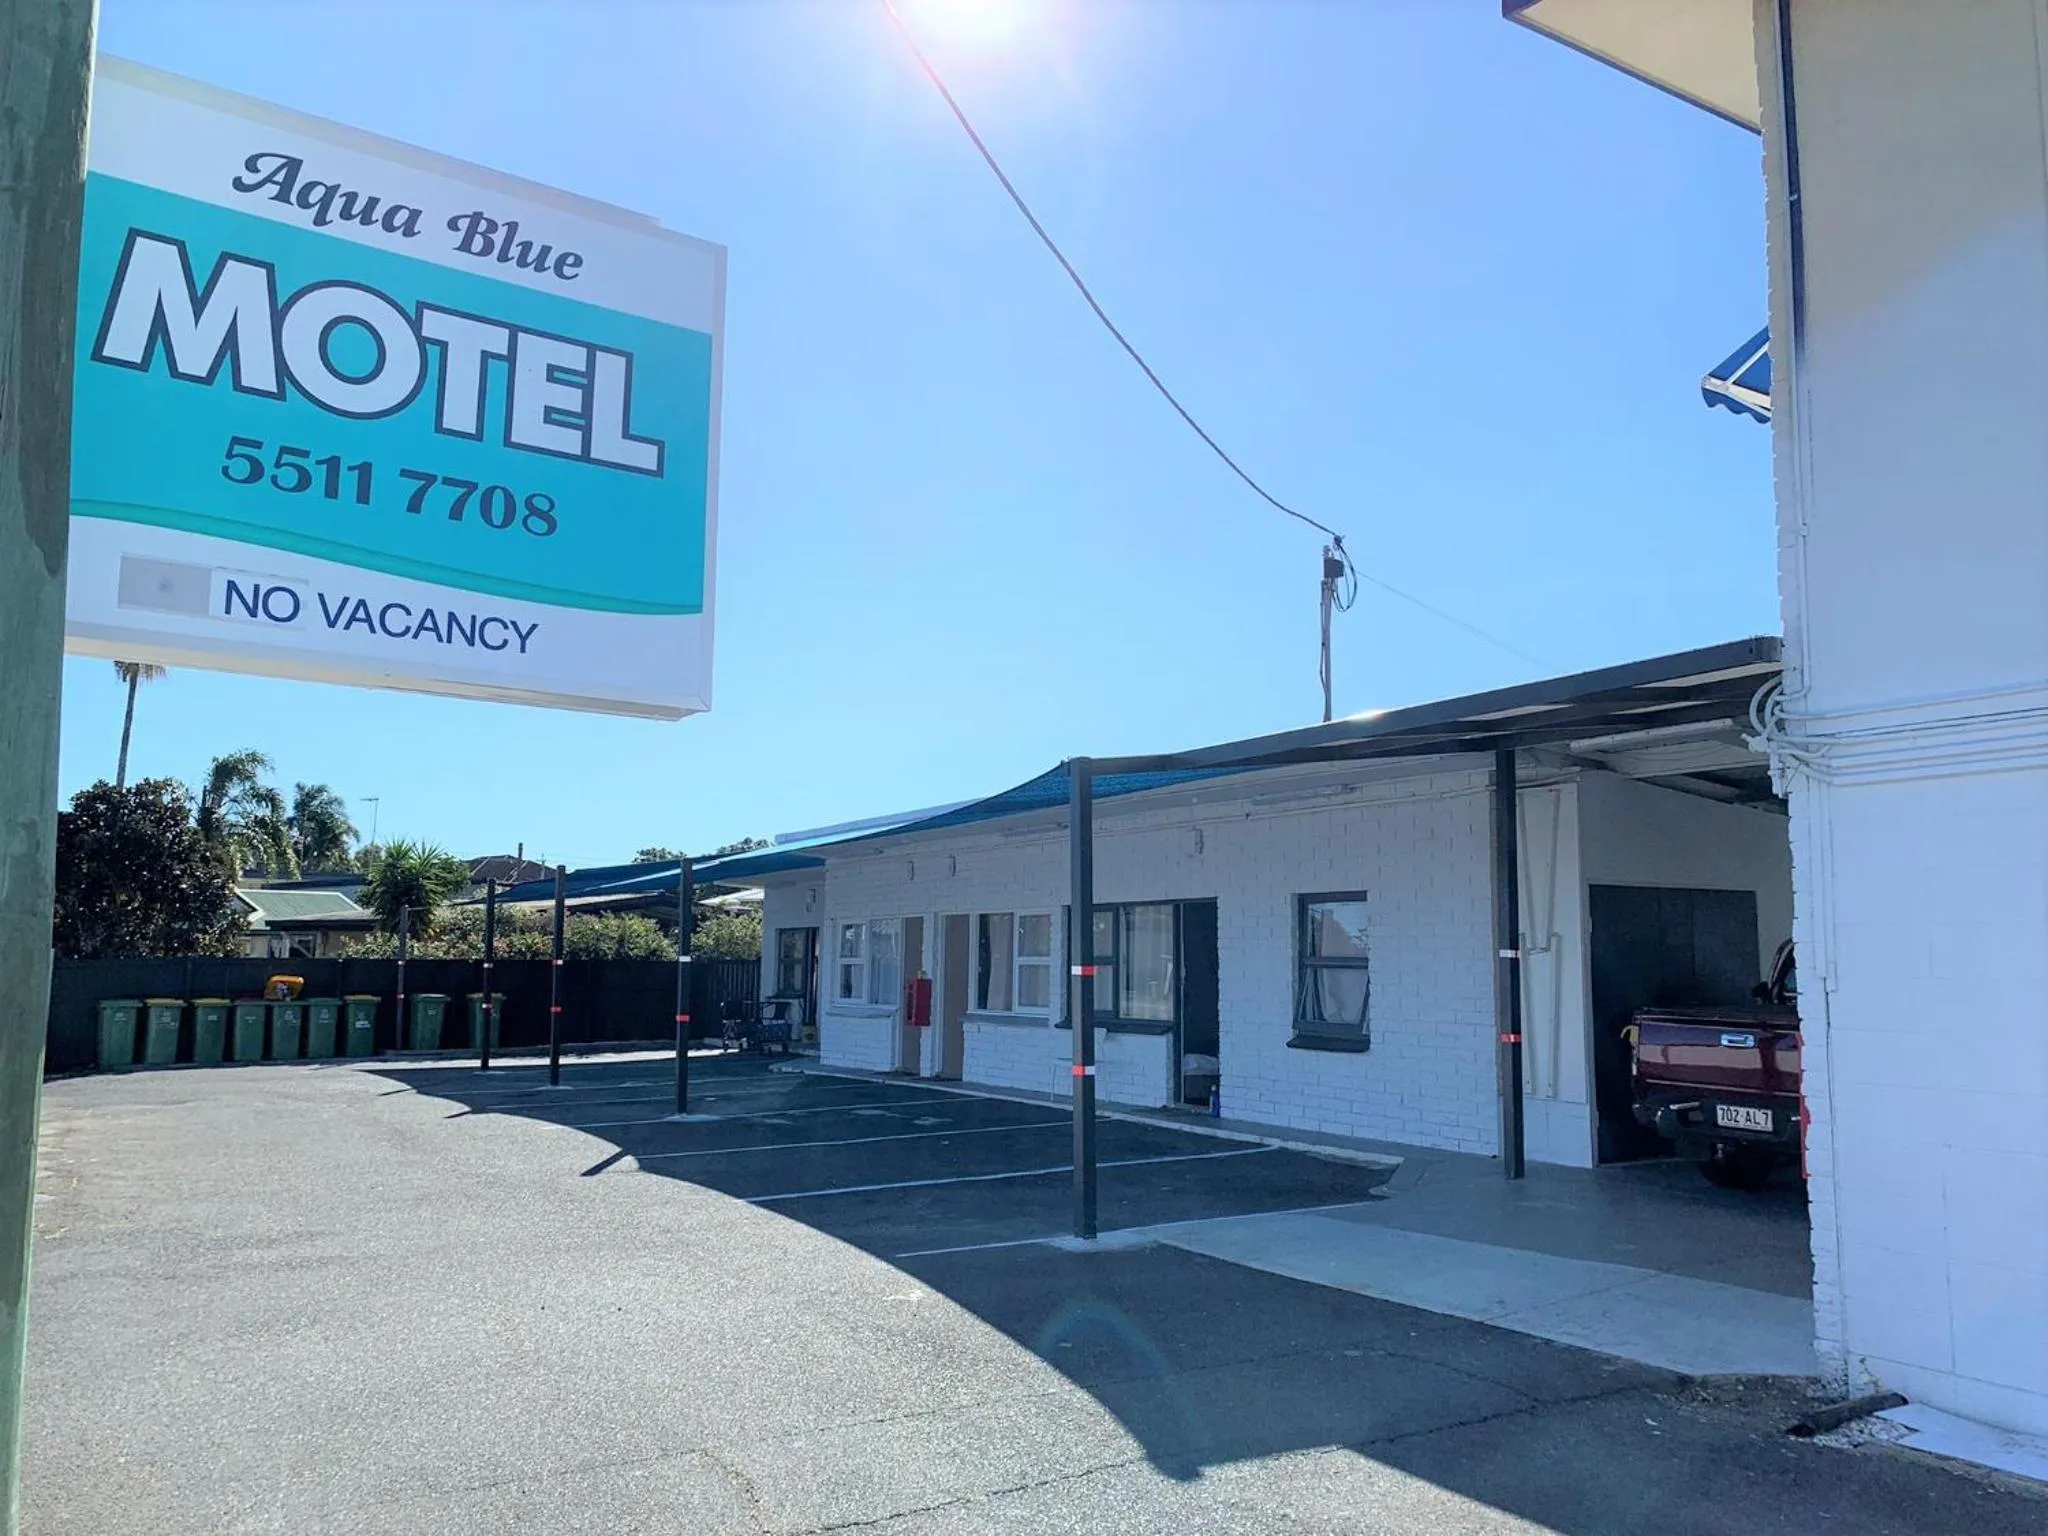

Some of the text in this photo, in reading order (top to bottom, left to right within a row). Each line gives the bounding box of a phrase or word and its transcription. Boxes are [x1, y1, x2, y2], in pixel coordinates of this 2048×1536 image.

[233, 152, 584, 281] Aqua Blue
[91, 227, 665, 478] MOTEL
[221, 436, 559, 537] 5511 7708
[224, 580, 539, 655] NO VACANCY
